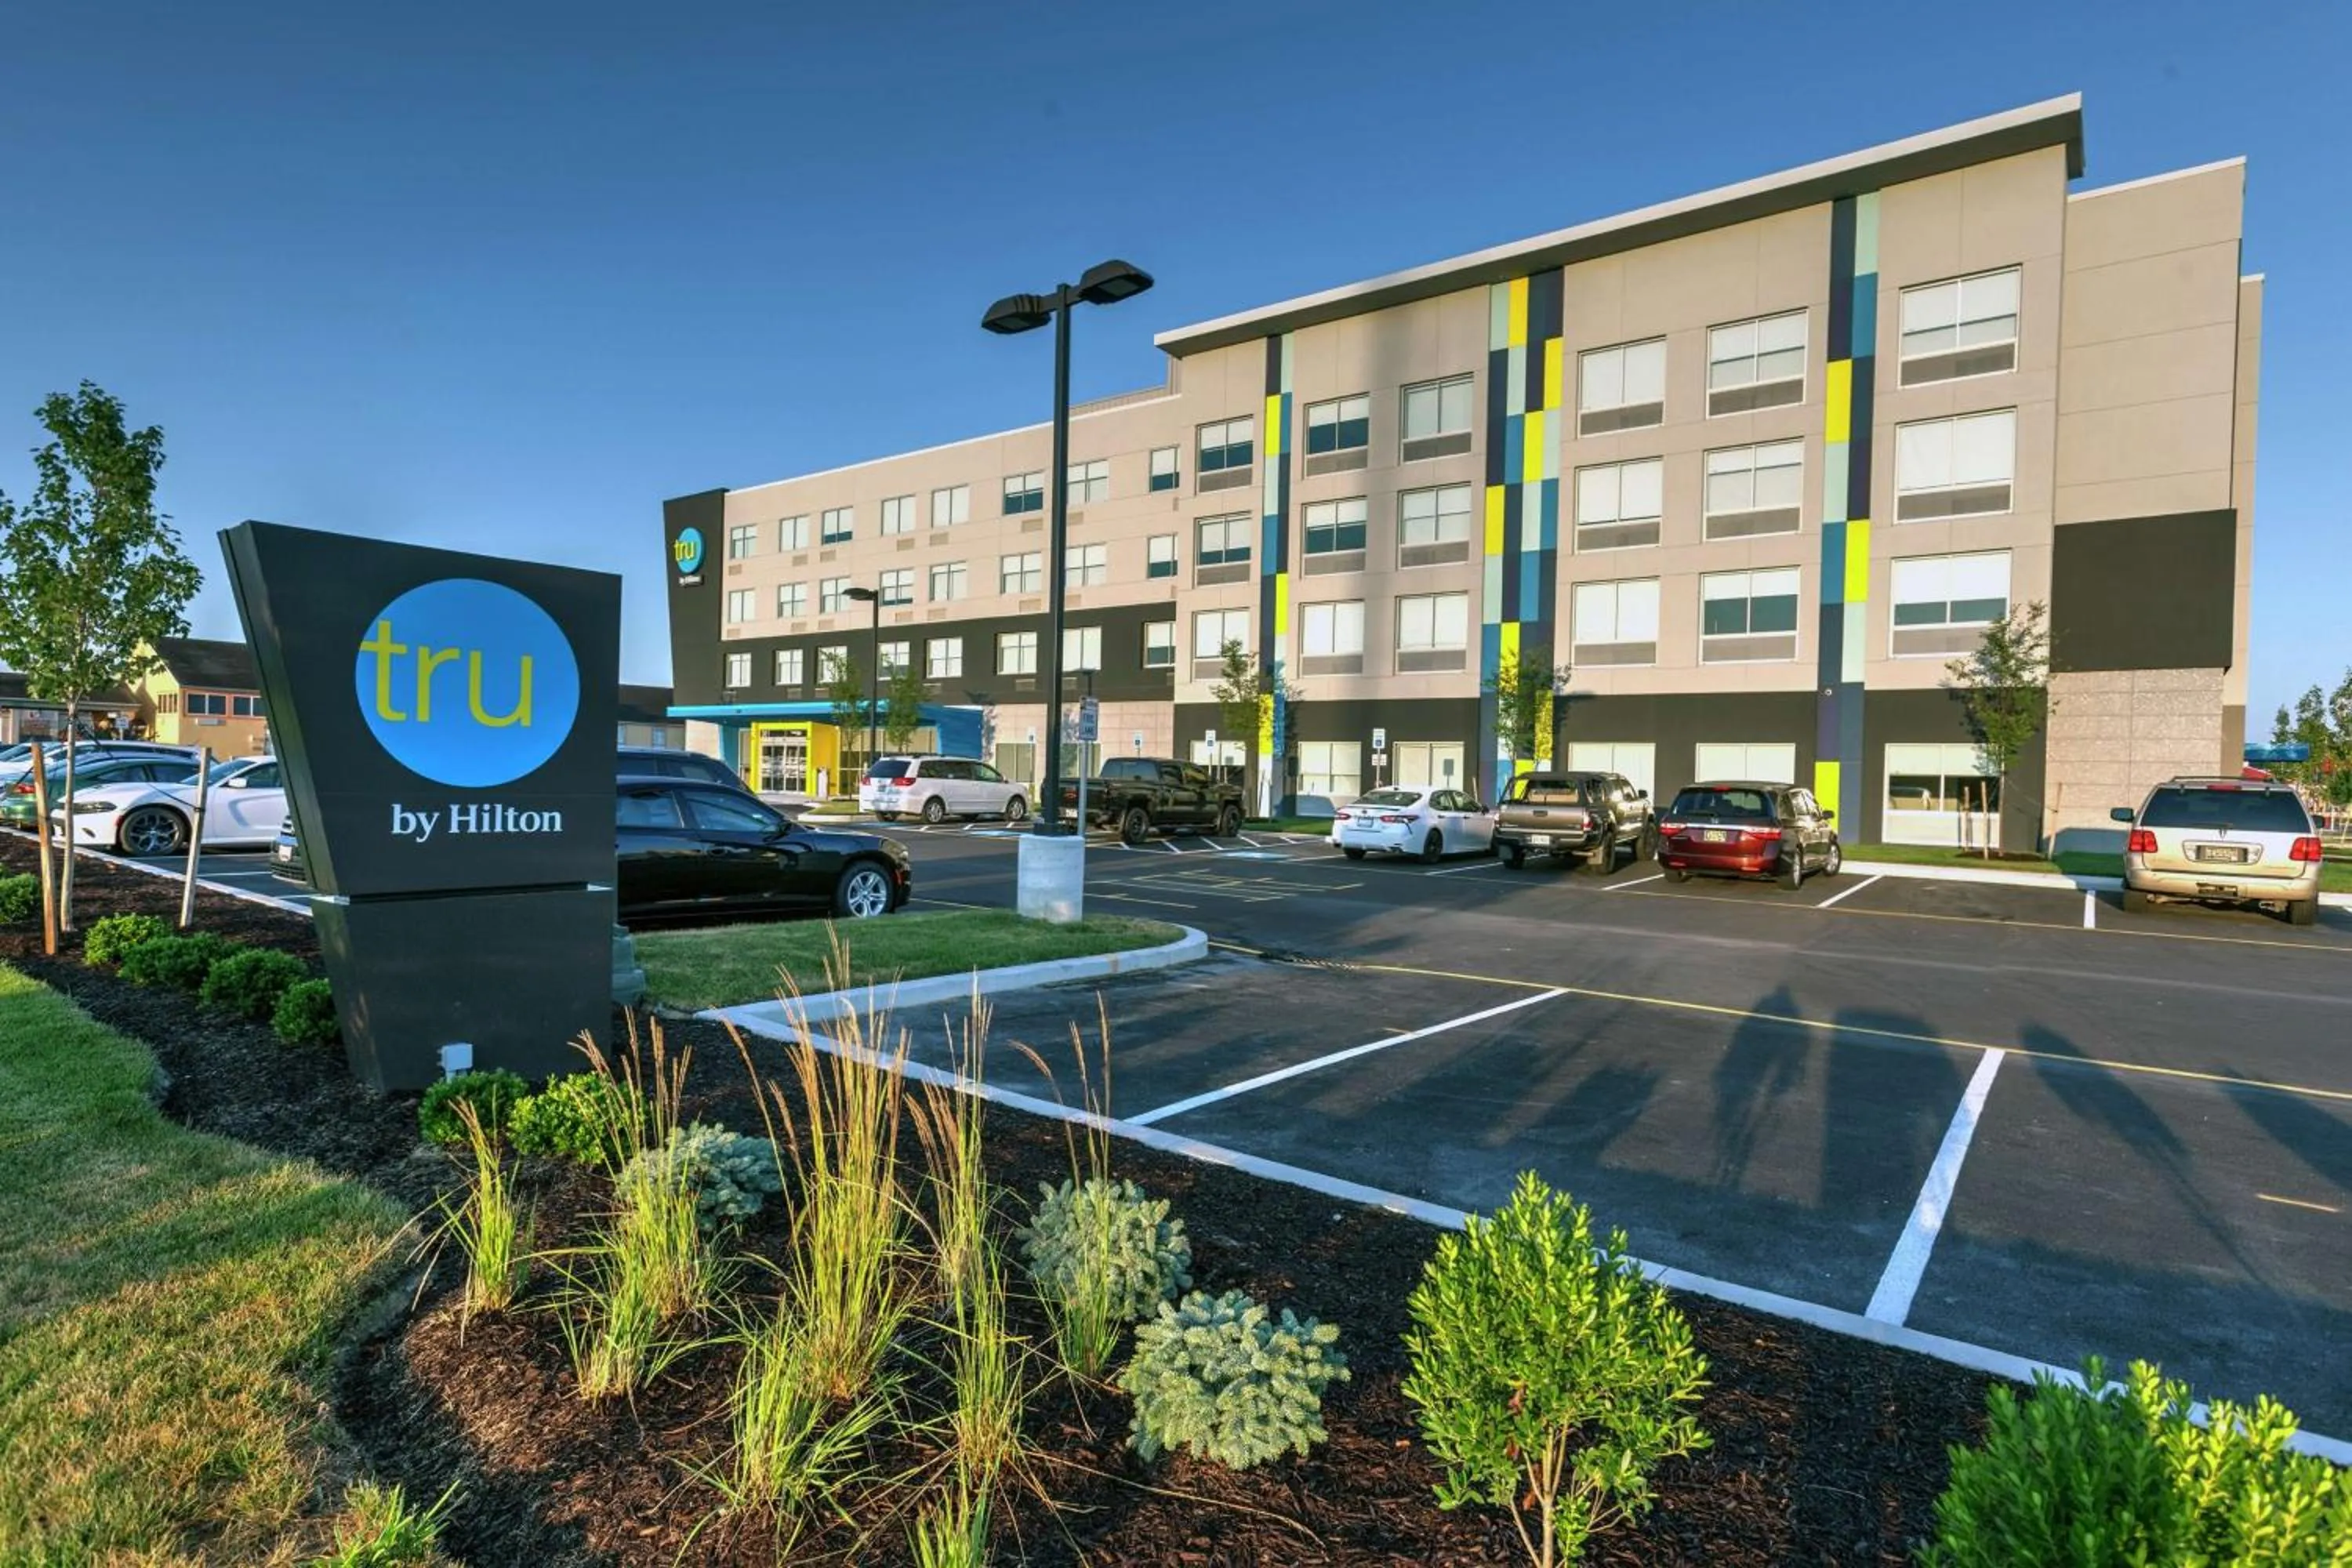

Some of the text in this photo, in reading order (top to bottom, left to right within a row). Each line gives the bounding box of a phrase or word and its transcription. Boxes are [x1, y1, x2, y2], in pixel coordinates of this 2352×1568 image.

[673, 539, 694, 562] tru
[360, 620, 533, 728] tru
[391, 804, 563, 843] by Hilton
